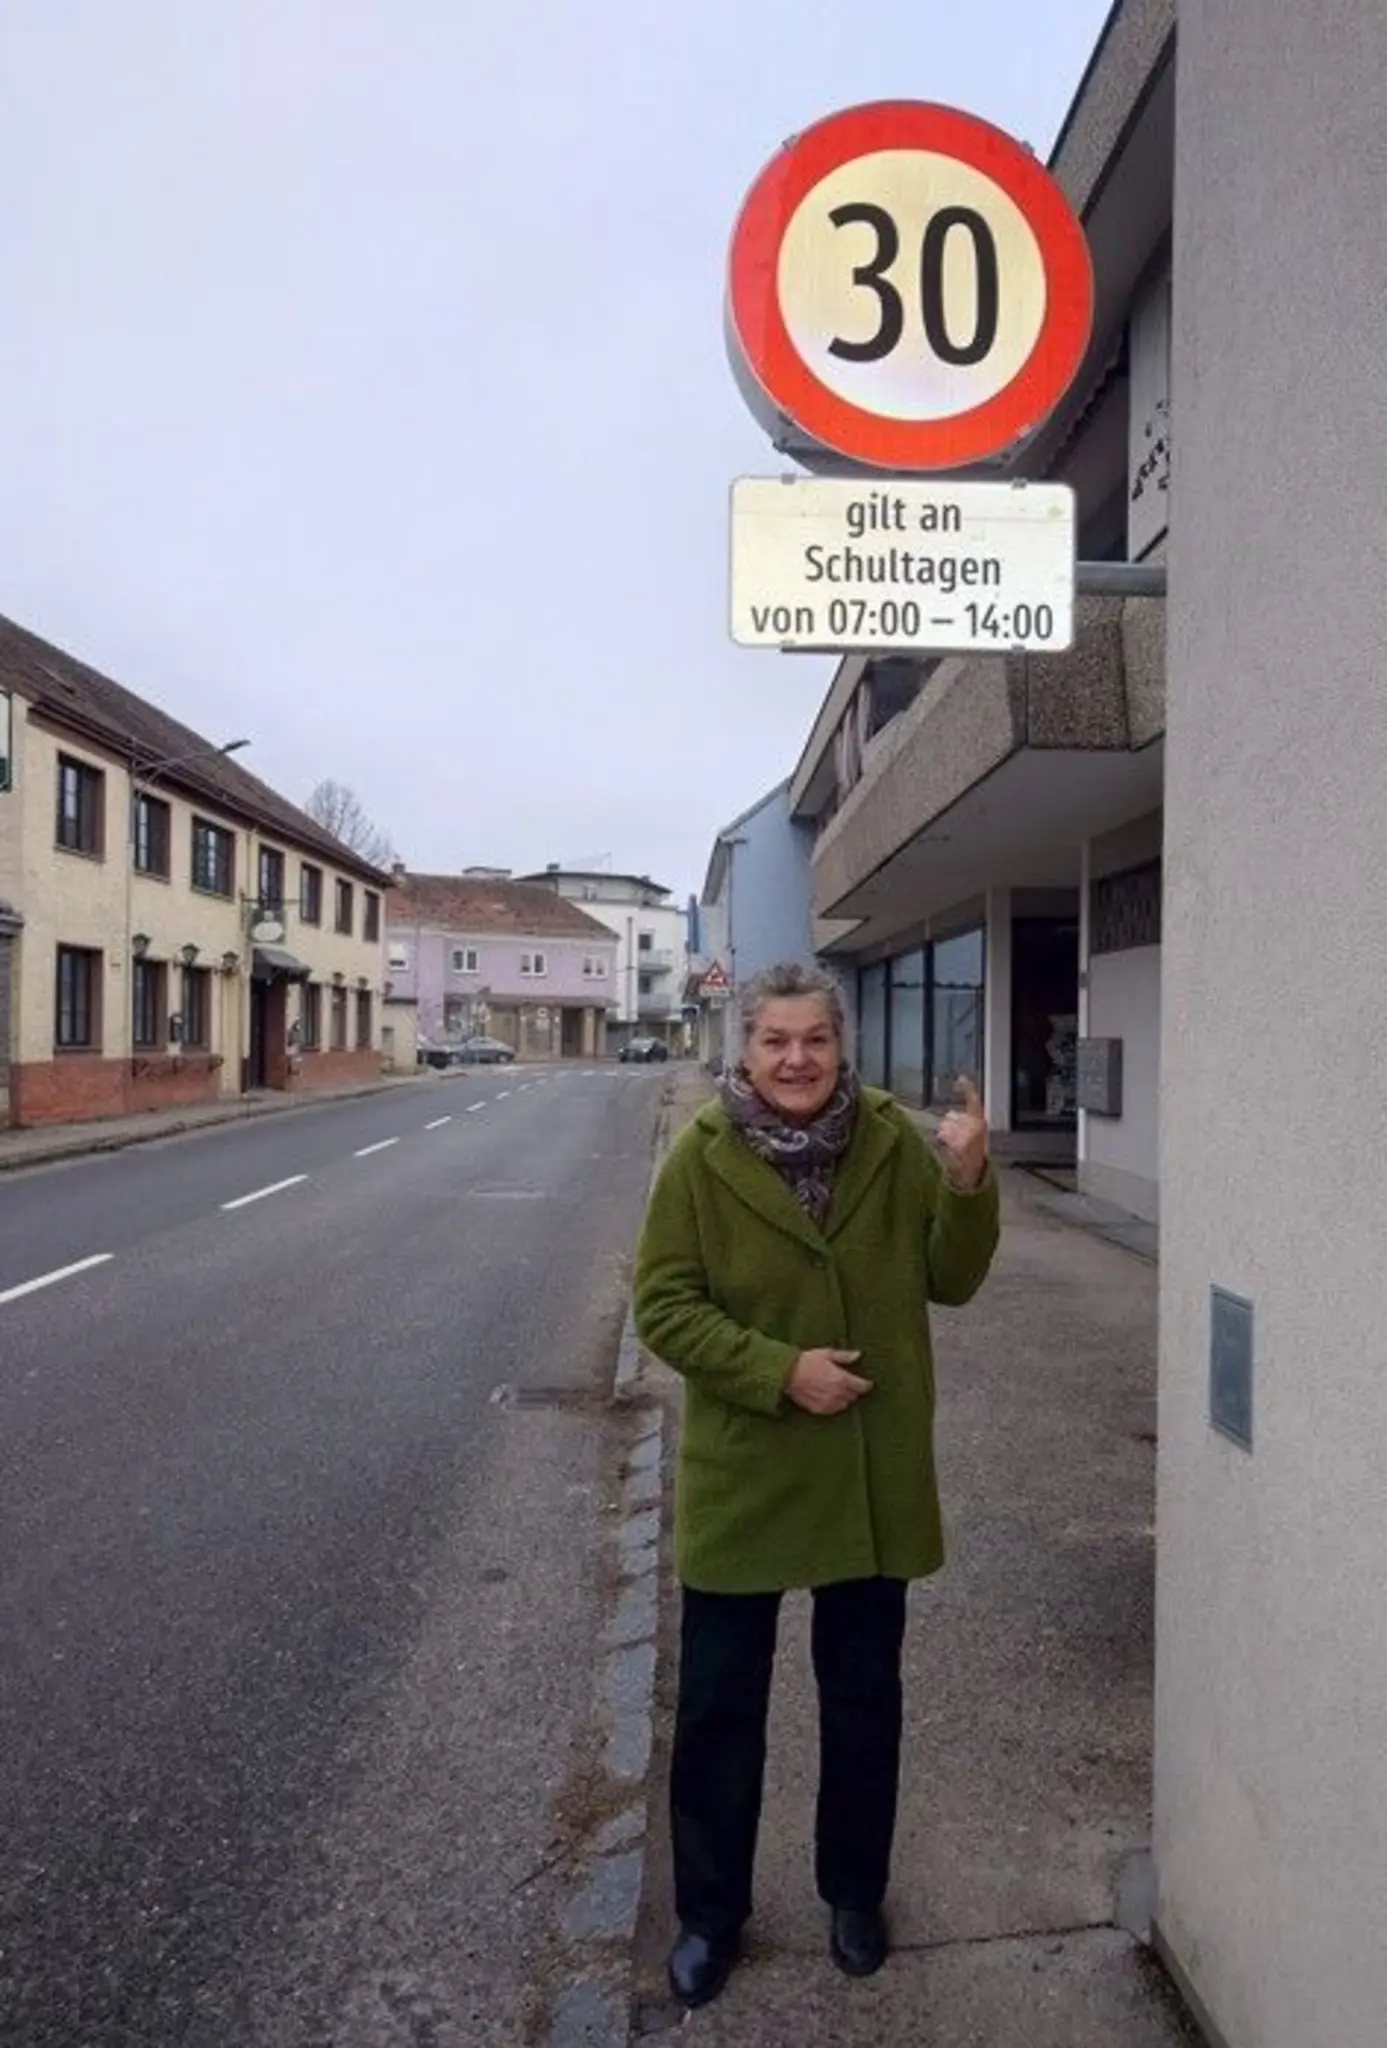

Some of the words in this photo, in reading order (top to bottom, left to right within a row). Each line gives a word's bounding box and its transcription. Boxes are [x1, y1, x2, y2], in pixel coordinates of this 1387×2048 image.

[827, 202, 999, 366] 30
[847, 494, 906, 538] gilt
[920, 504, 961, 531] an
[805, 545, 1000, 593] Schultagen
[752, 606, 813, 633] von
[829, 599, 920, 636] 07:00
[965, 603, 1053, 639] 14:00
